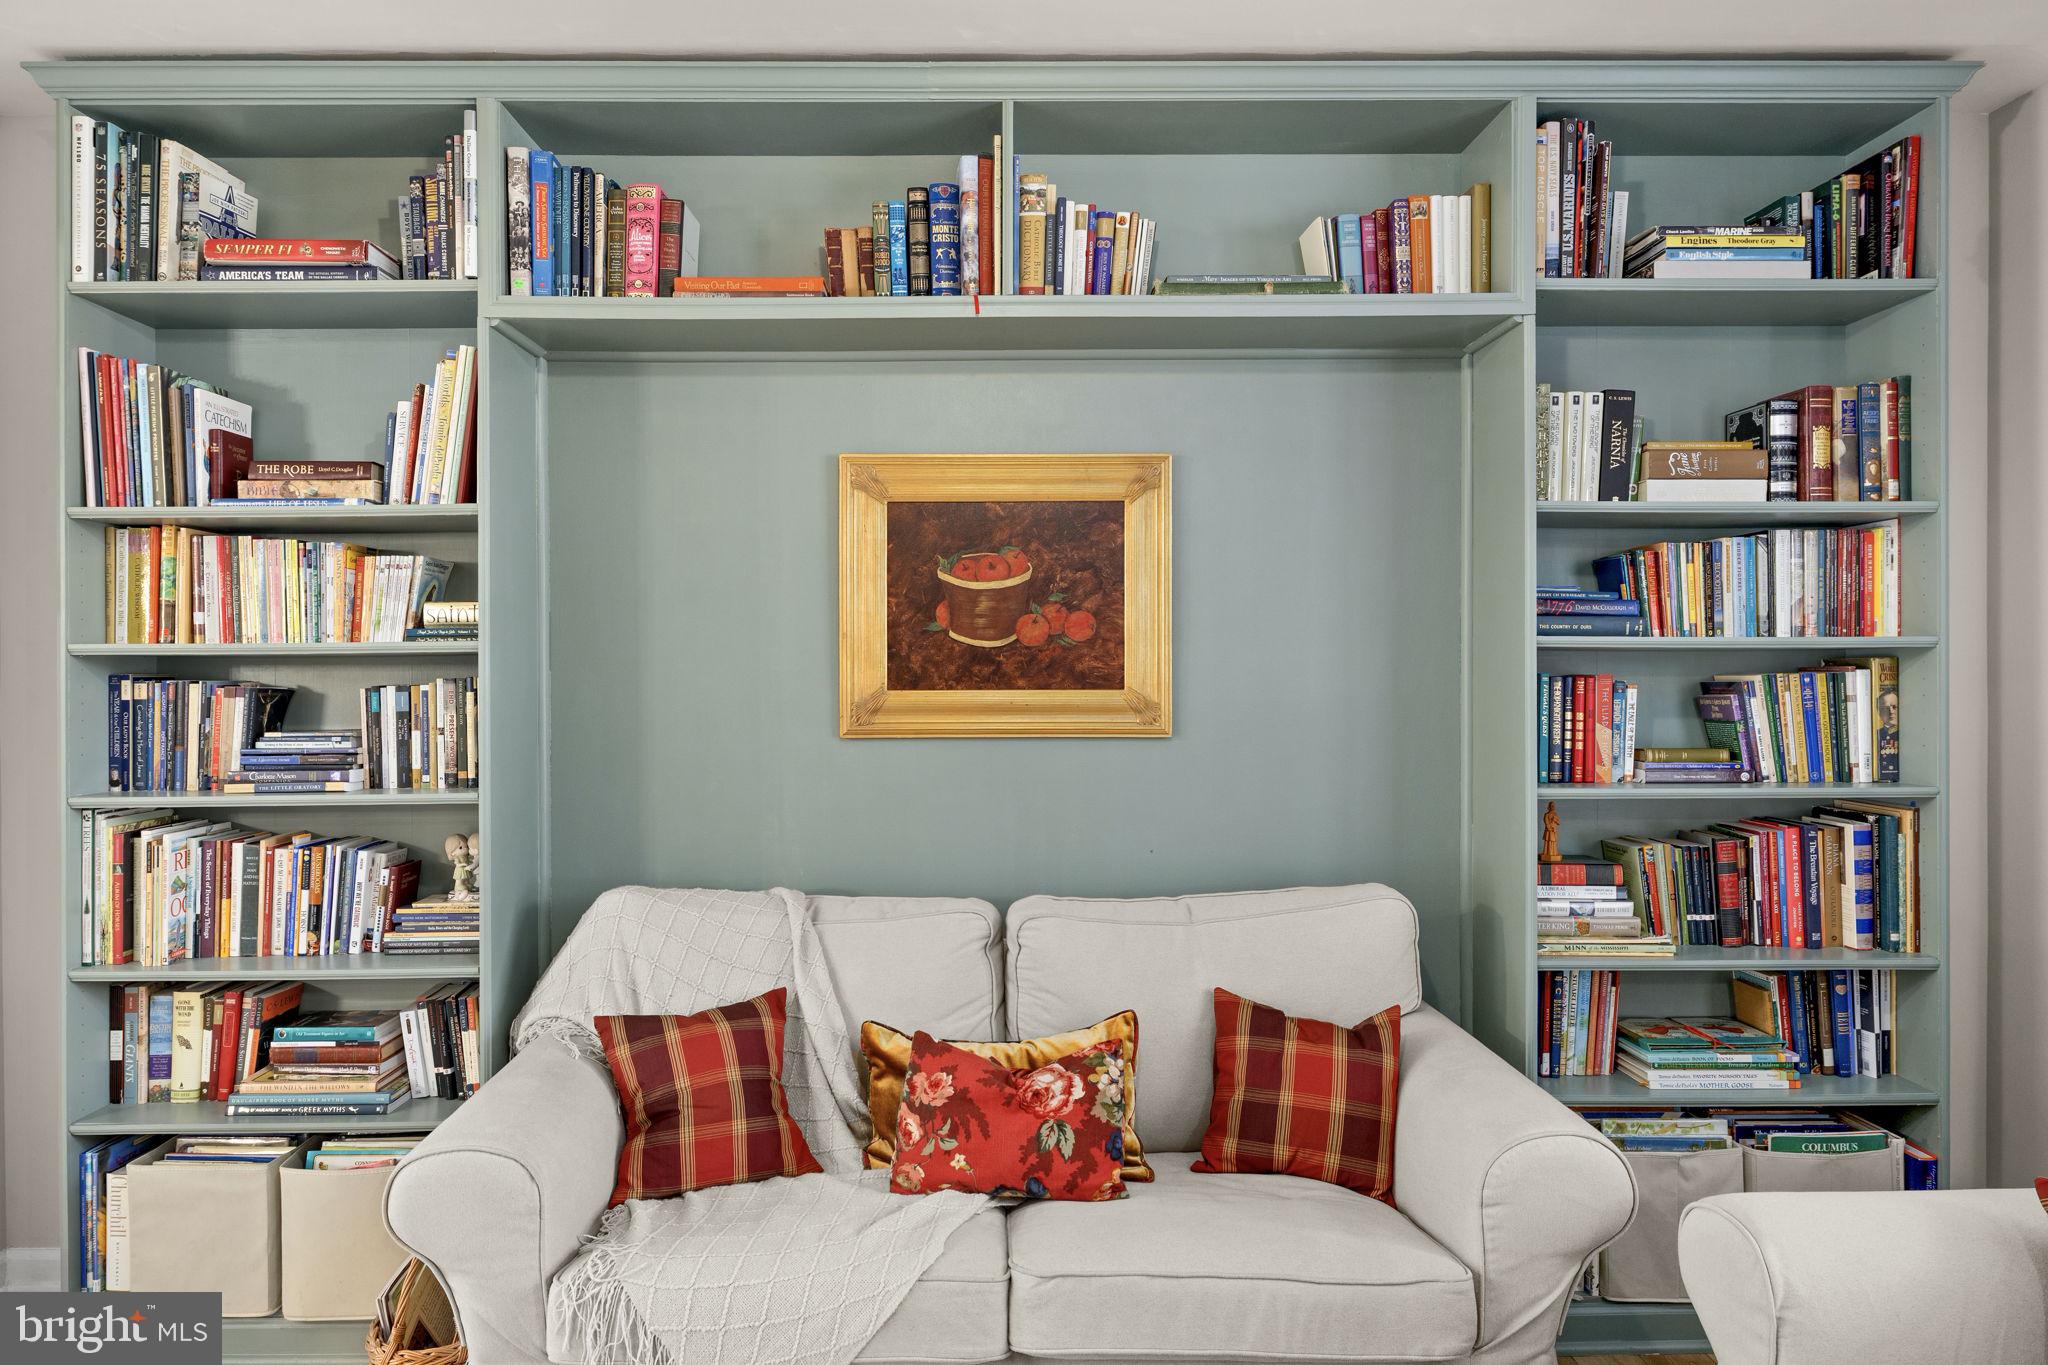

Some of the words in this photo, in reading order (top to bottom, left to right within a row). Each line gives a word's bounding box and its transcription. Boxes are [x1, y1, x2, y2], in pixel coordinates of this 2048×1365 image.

[96, 154, 106, 170] 75
[162, 160, 170, 176] THE
[141, 196, 150, 204] THE
[426, 178, 438, 224] SHOWTIME
[440, 196, 448, 223] CHANGERS
[96, 178, 106, 248] SEASONS
[140, 206, 150, 224] MAMBA
[160, 178, 170, 246] PROFESSIONALS
[412, 202, 420, 234] STAUBACH
[572, 210, 580, 238] Discovery
[932, 225, 959, 234] MONTE
[140, 224, 149, 248] MENTALITY
[932, 234, 959, 243] CRISTO
[1681, 236, 1717, 245] Engines
[214, 243, 273, 255] SEMPER
[1022, 220, 1033, 282] DICTIONARY
[1680, 251, 1712, 260] English
[1712, 251, 1735, 260] Style
[219, 270, 272, 280] AMERICA'S
[275, 271, 304, 280] TEAM
[711, 281, 726, 289] Our
[726, 281, 740, 289] Past
[440, 375, 452, 408] Worlds
[204, 410, 247, 434] CATECHISM
[398, 410, 406, 448] SERVICE
[436, 416, 448, 443] Tomie
[1610, 420, 1622, 470] NARNIA
[257, 464, 280, 474] THE
[283, 464, 314, 477] ROBE
[432, 446, 444, 480] dePaola
[135, 704, 144, 731] Consoling
[249, 772, 277, 781] Charlotte
[1793, 862, 1798, 870] TO
[1810, 884, 1818, 905] Voyage
[1838, 1012, 1850, 1035] HEIDI
[126, 1044, 136, 1082] GIANTS
[1800, 1142, 1857, 1152] COLUMBUS
[110, 1177, 128, 1238] Churchill
